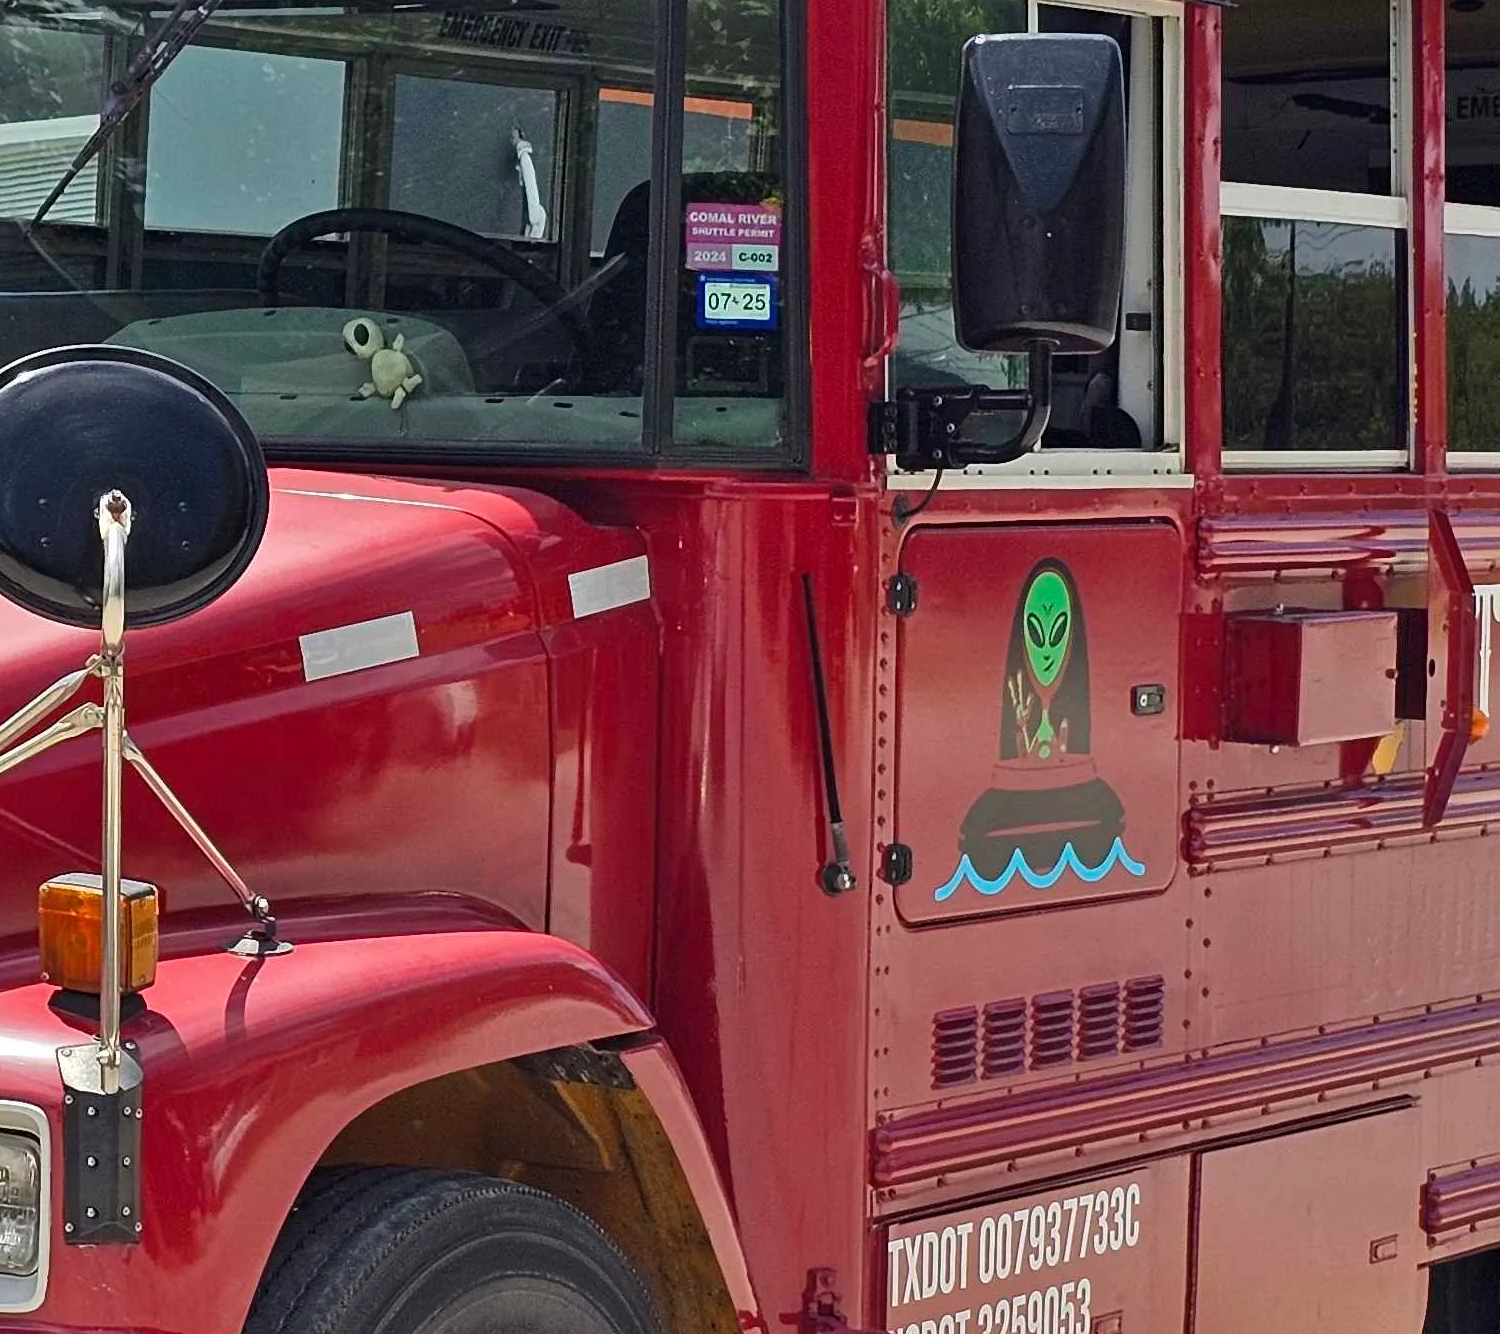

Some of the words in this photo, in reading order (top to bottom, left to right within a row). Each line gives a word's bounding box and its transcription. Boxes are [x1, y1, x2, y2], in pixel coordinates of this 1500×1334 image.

[438, 10, 531, 48] EMERGENCY
[529, 22, 567, 52] EXIT
[690, 211, 734, 224] COMAL
[738, 213, 777, 225] RIVER
[691, 227, 736, 237] SHUTTLE
[738, 228, 775, 238] PERMIT
[693, 250, 727, 263] 2024
[738, 252, 773, 263] C-002
[887, 1222, 974, 1307] TXDOT
[978, 1183, 1141, 1284] 007937733C
